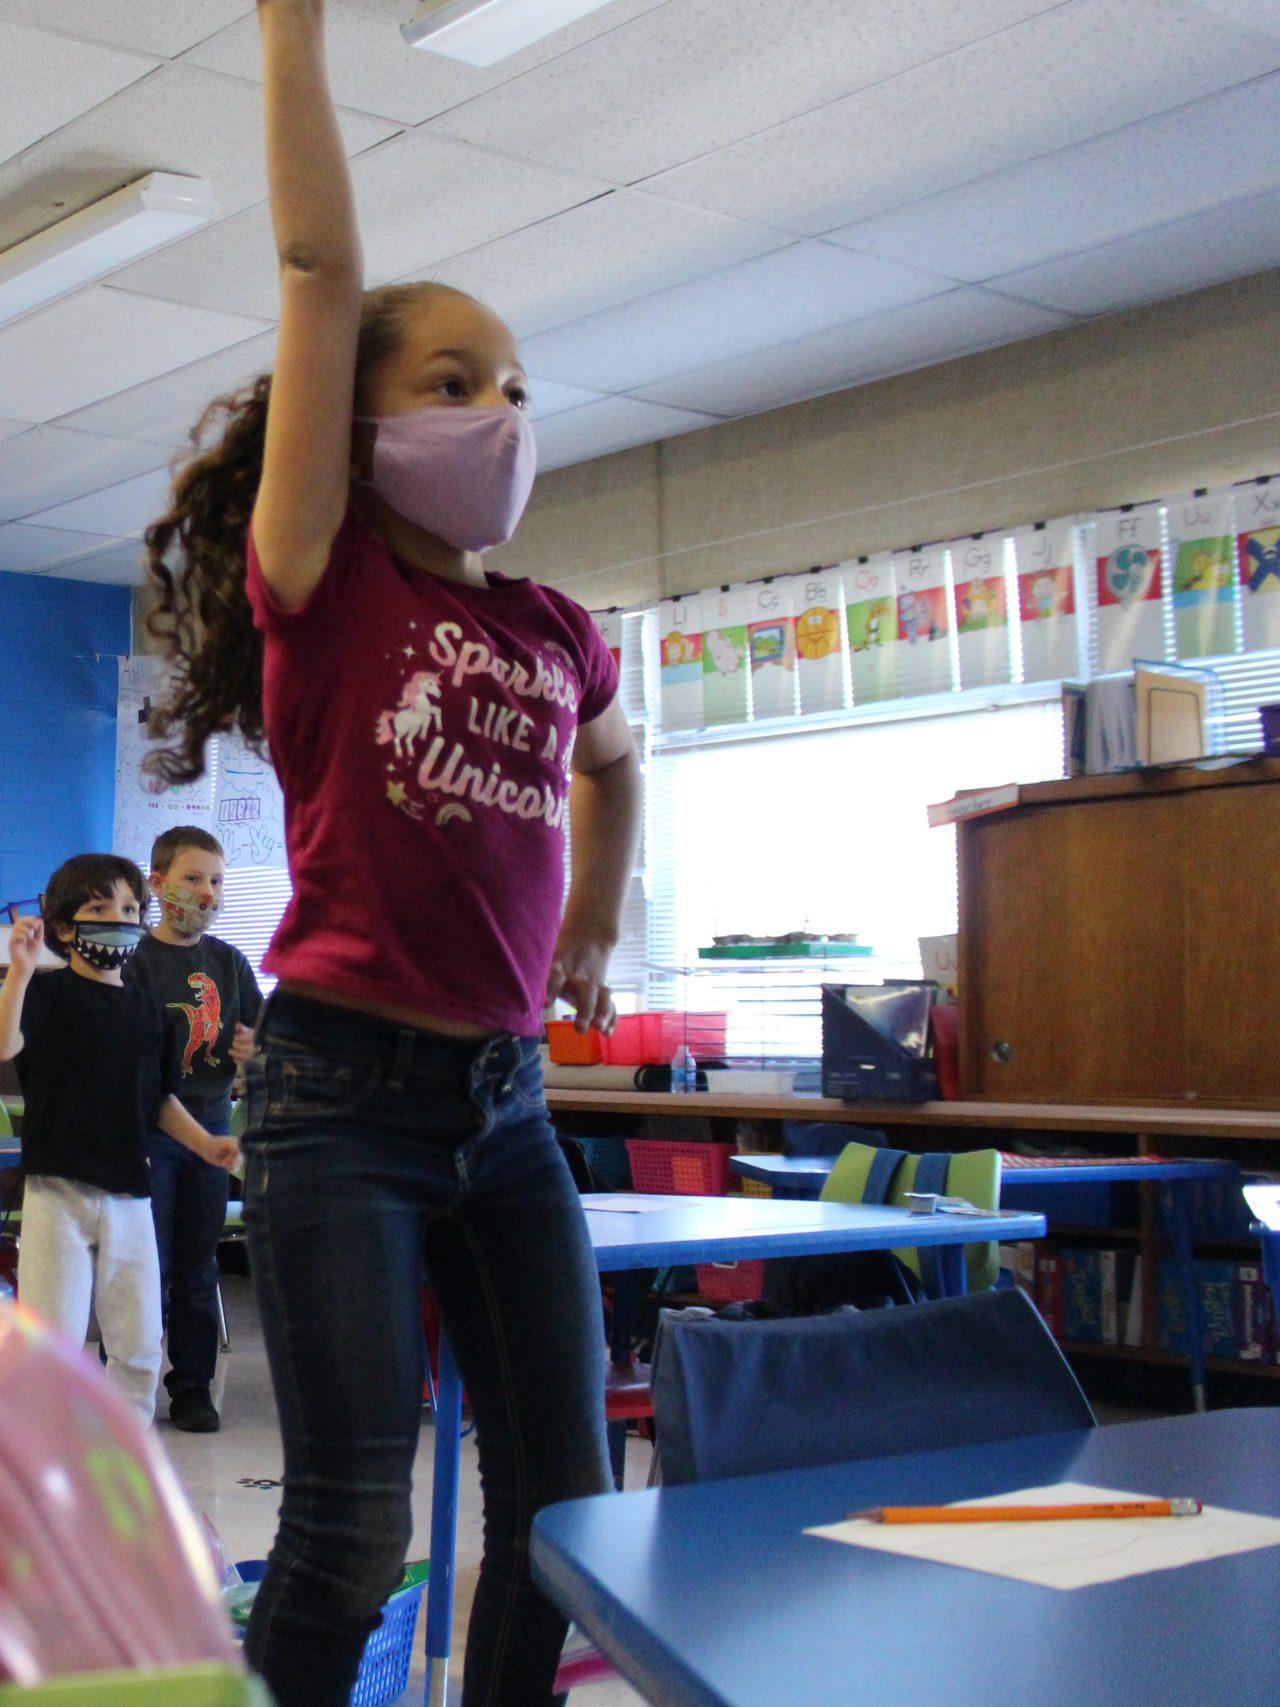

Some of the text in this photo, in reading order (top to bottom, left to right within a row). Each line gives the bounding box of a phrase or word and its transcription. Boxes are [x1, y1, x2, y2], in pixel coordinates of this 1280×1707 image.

[1118, 517, 1141, 540] Ff
[1183, 506, 1211, 526] Uu
[964, 547, 992, 574] Gg
[429, 621, 578, 713] Sparkle
[467, 696, 557, 762] LIKE A
